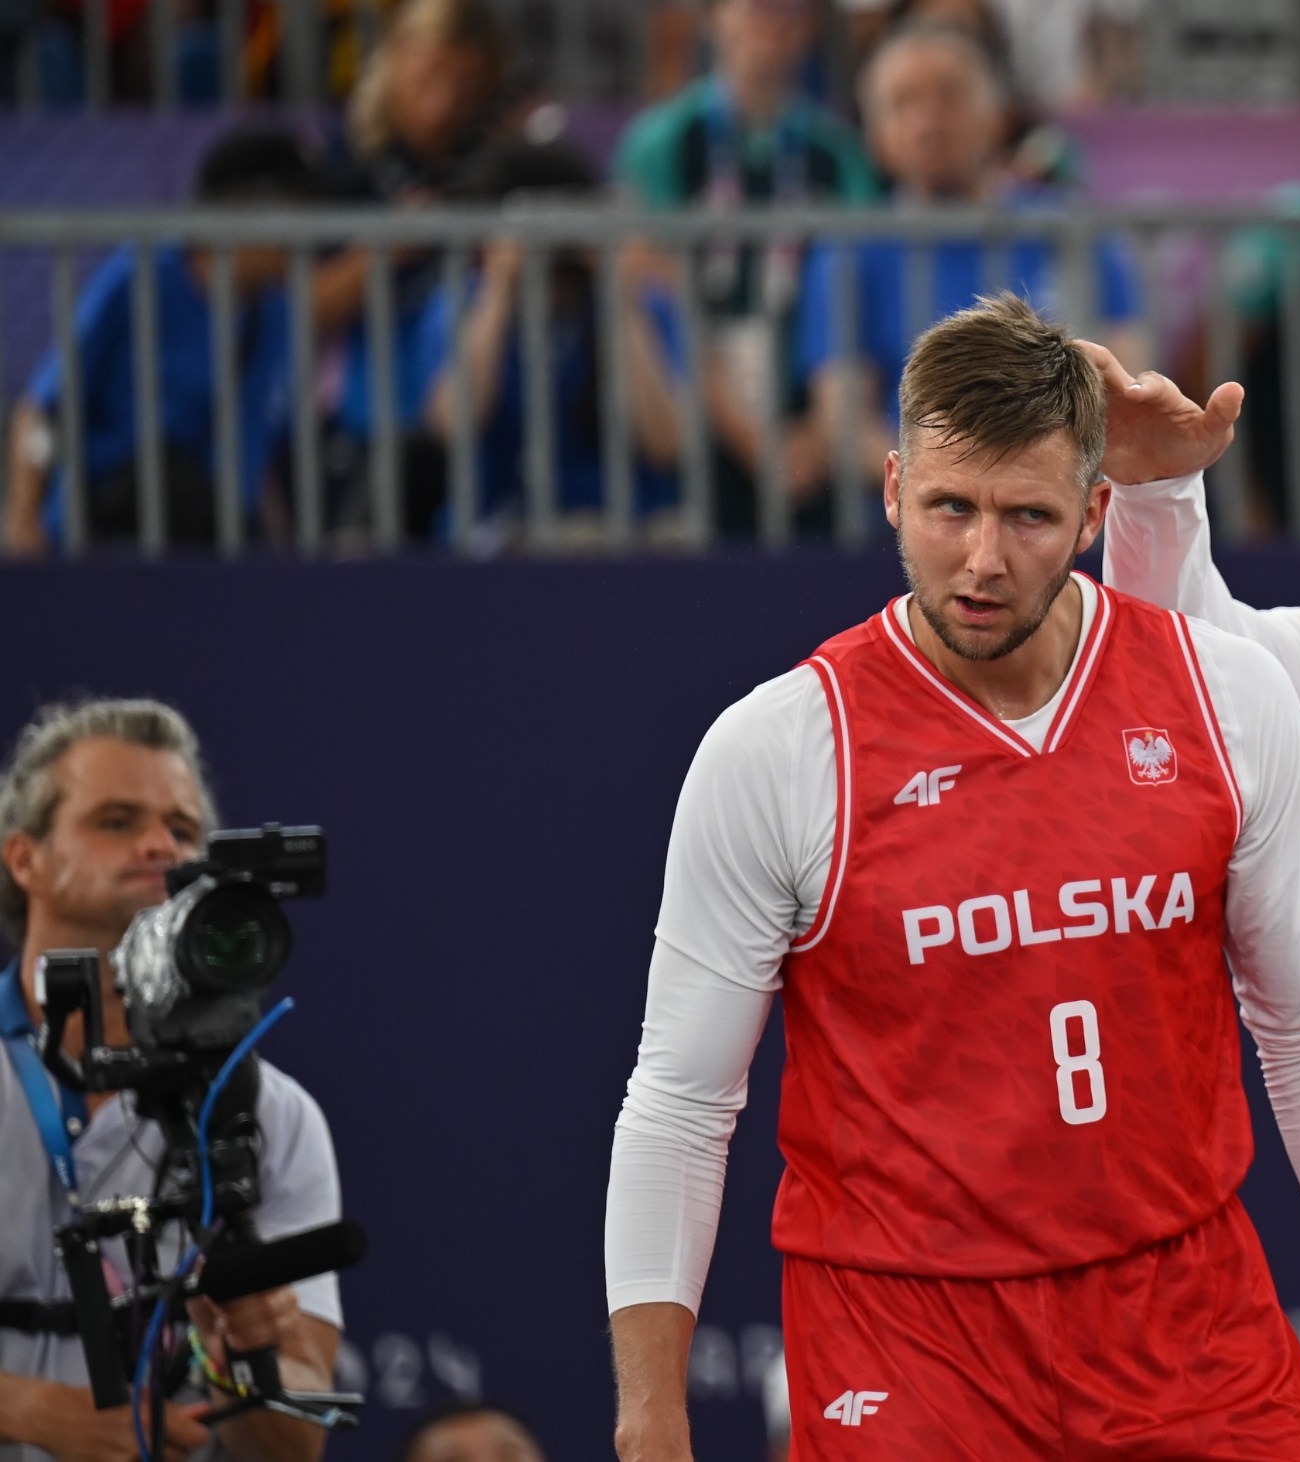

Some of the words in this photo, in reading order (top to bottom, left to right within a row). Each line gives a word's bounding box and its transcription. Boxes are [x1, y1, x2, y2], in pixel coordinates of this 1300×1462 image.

[893, 764, 963, 807] 4F
[901, 872, 1195, 965] POLSKA
[1049, 999, 1107, 1125] 8
[823, 1390, 889, 1426] 4F
